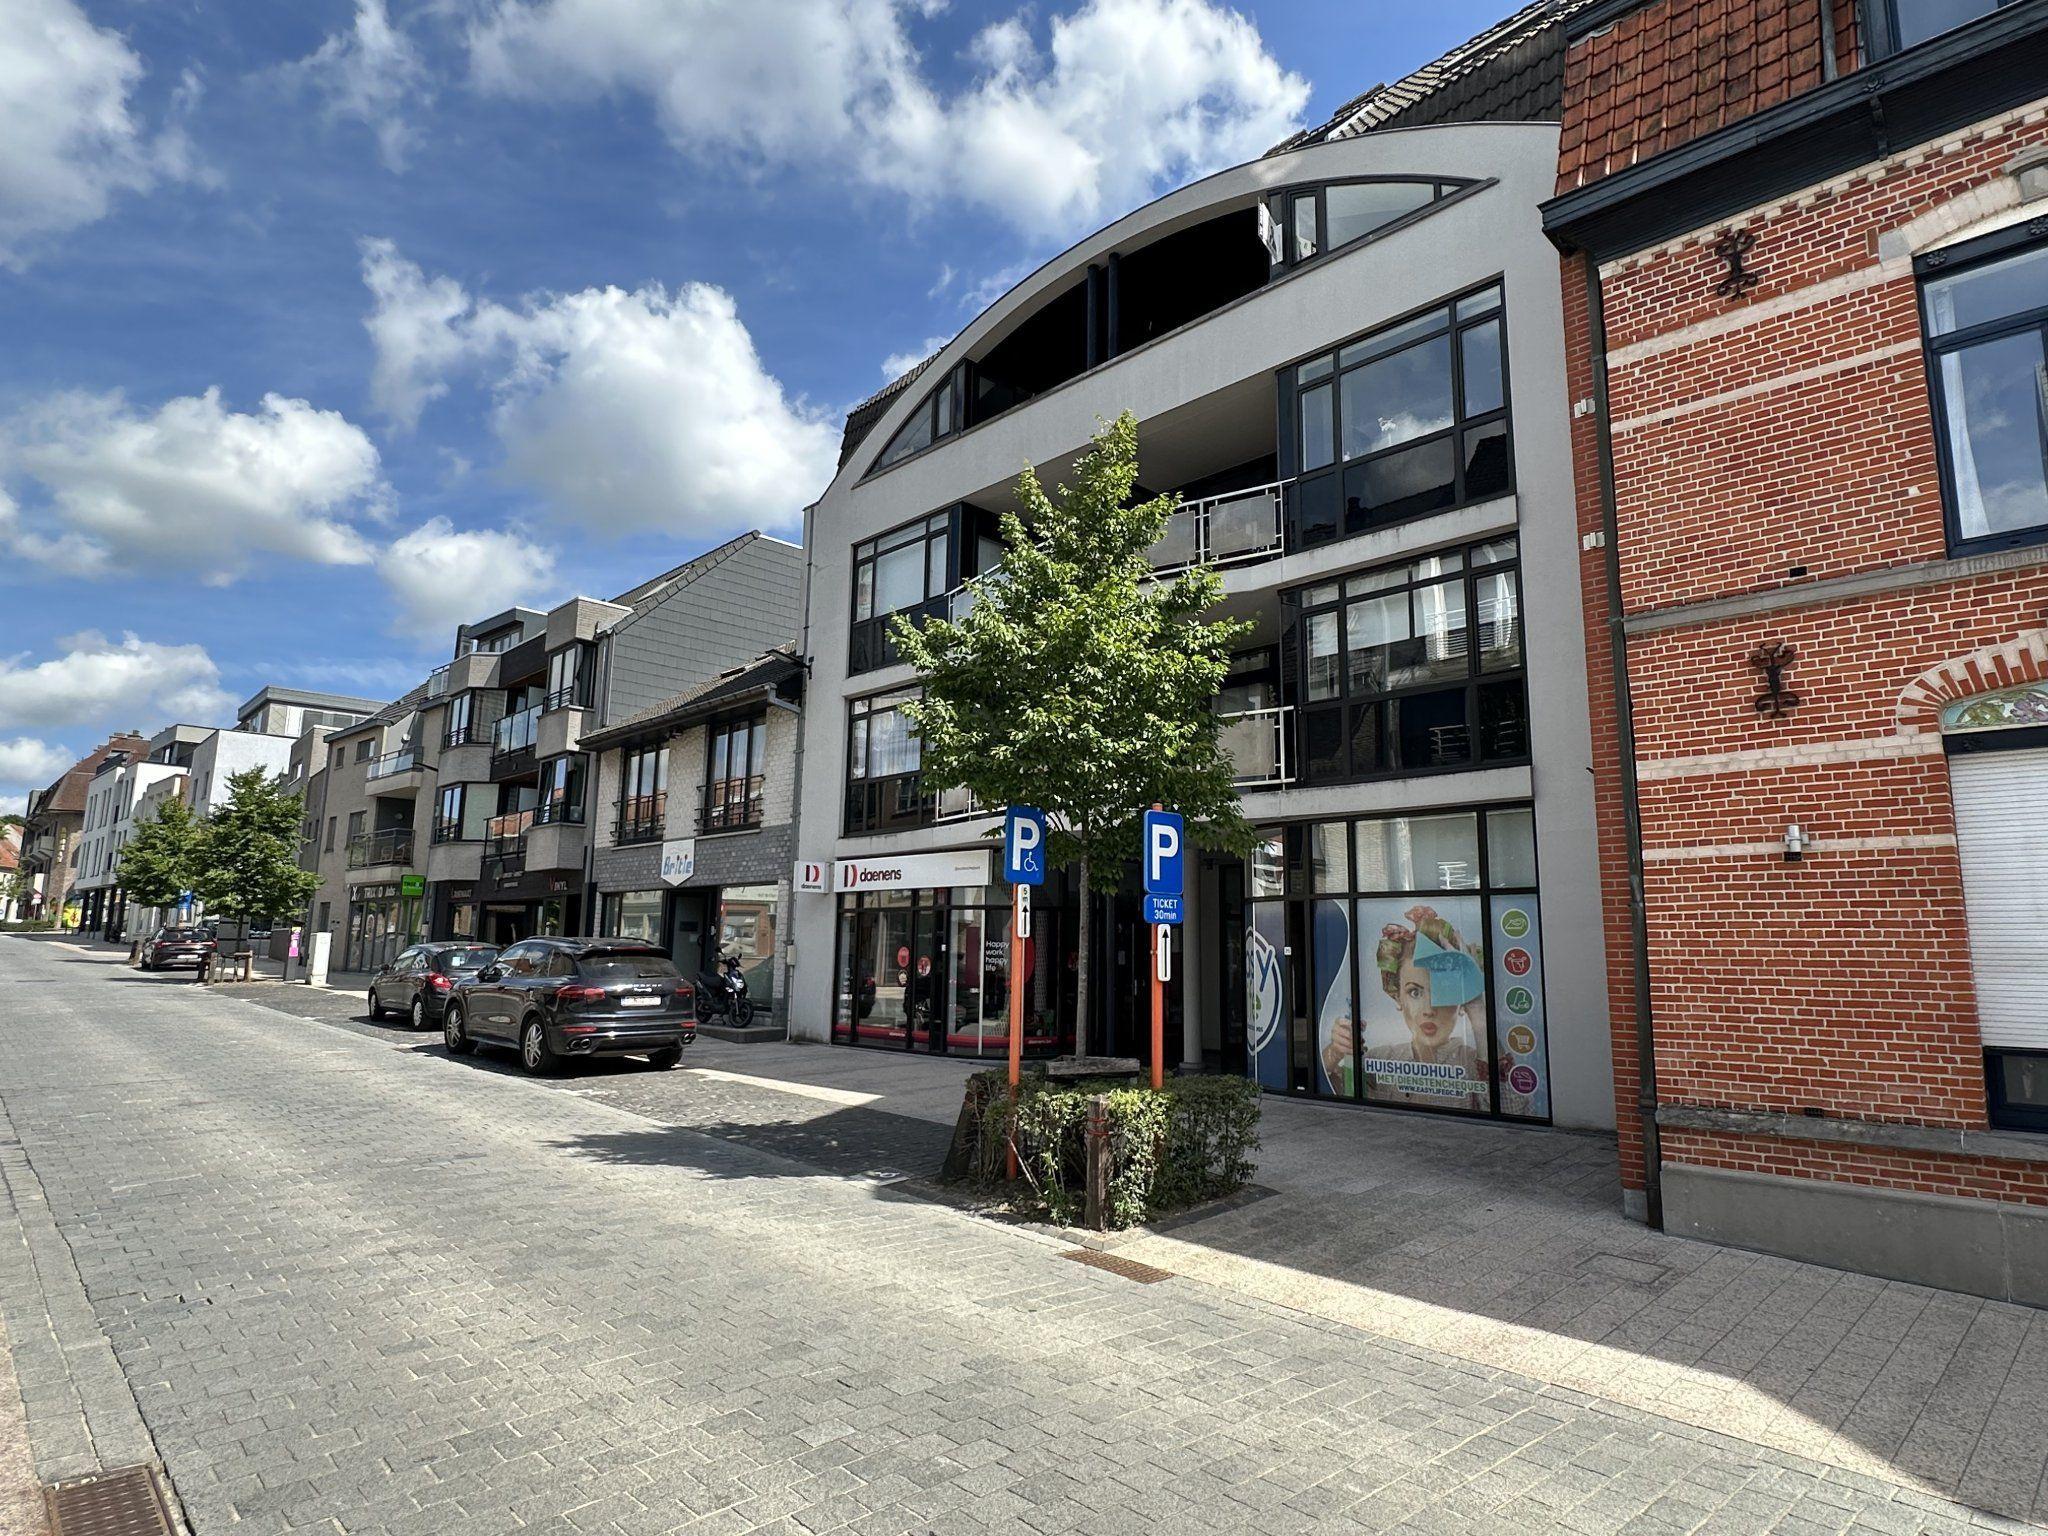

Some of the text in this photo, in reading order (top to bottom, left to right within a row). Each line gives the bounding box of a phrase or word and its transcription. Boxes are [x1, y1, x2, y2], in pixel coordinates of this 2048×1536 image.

[1012, 816, 1041, 871] P
[1152, 823, 1179, 880] P
[860, 868, 902, 882] daenens
[1023, 887, 1028, 895] 5
[1152, 898, 1178, 909] TICKET
[1154, 909, 1177, 920] 30min
[985, 940, 1010, 950] Happy
[985, 956, 1009, 966] happy
[985, 963, 997, 972] life
[1366, 1059, 1464, 1079] HUISHOUDHULP
[1377, 1074, 1487, 1092] MET DIENSTENCHEQUES
